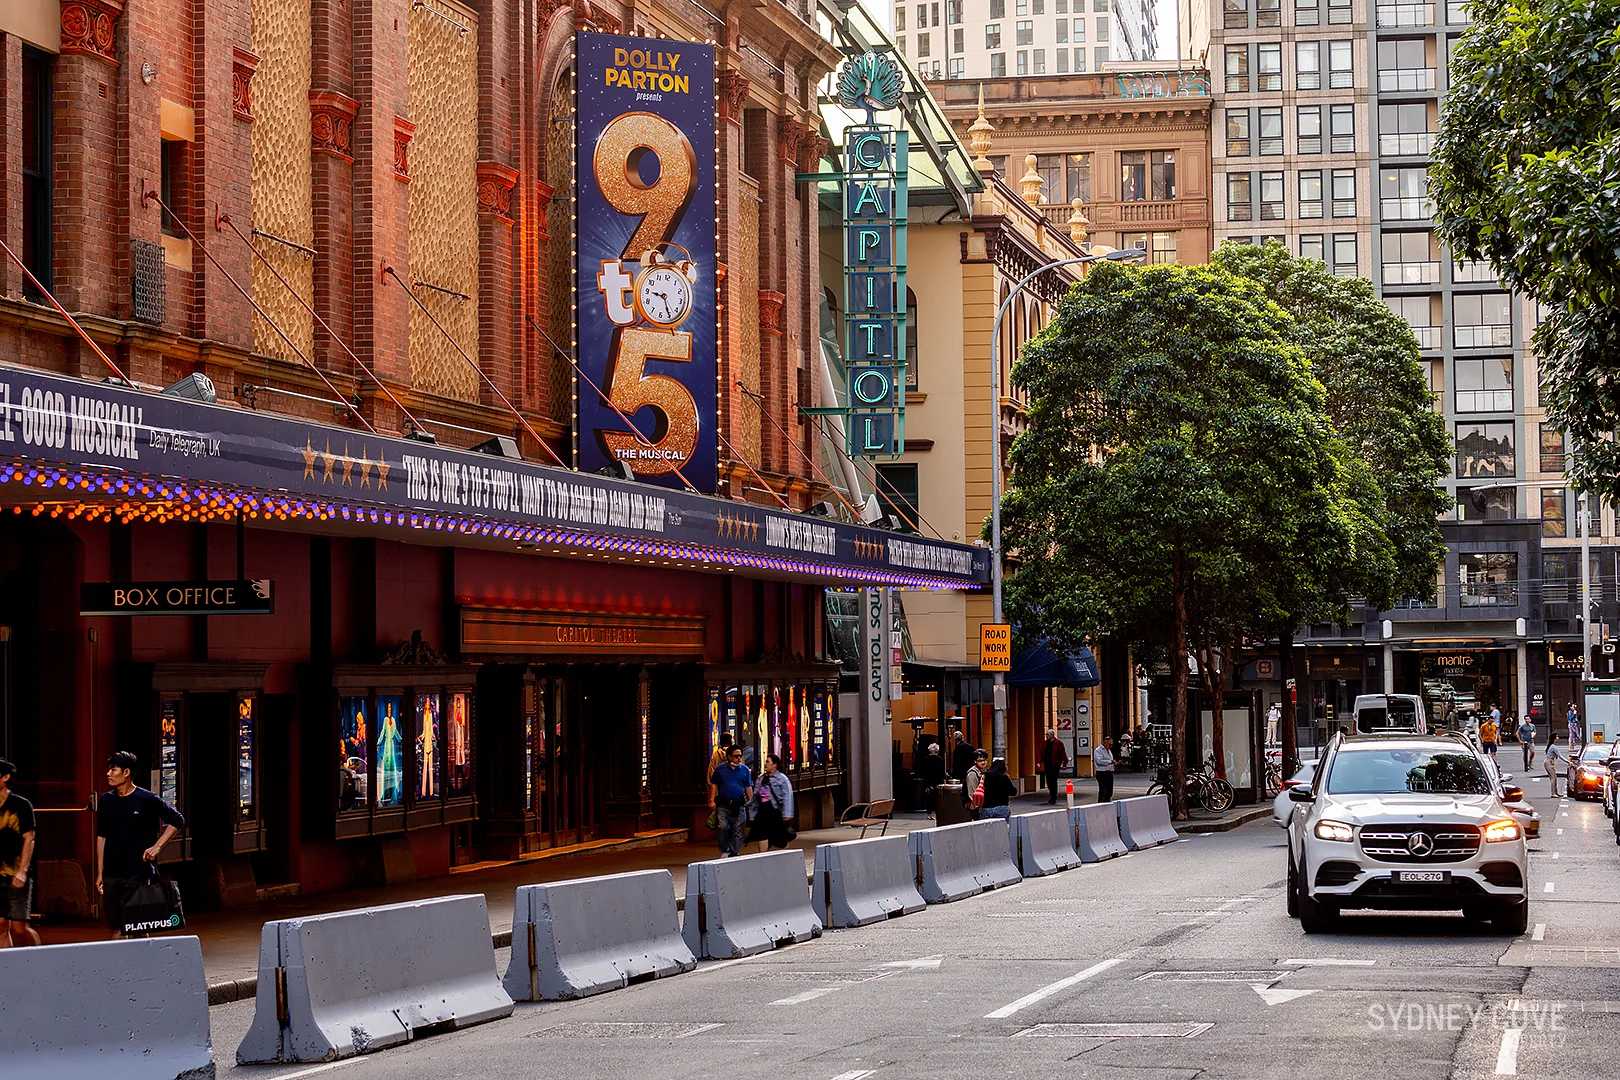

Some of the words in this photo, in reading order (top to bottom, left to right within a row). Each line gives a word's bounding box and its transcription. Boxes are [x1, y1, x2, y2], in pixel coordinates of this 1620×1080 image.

[614, 48, 680, 71] DOLLY
[606, 67, 689, 93] PARTON
[636, 92, 663, 102] presents
[593, 111, 699, 261] 9
[854, 134, 888, 450] CAPITOL
[593, 328, 700, 477] 5
[150, 429, 168, 453] Daily
[169, 432, 207, 458] Telegraph,
[208, 438, 221, 456] UK
[615, 449, 636, 459] THE
[638, 450, 686, 460] MUSICAL
[430, 459, 440, 502] IS
[441, 461, 460, 505] ONE
[461, 465, 469, 506] 9
[470, 466, 482, 508] TO
[482, 468, 490, 509] 5
[520, 475, 544, 516] WANT
[114, 588, 159, 606] BOX
[167, 588, 236, 605] OFFICE
[556, 626, 595, 642] CAPITOL
[600, 628, 637, 643] THEATRE
[985, 630, 1006, 639] ROAD
[985, 644, 1007, 652] WORK
[871, 634, 882, 702] CAPITOL
[982, 657, 1009, 666] AHEAD
[1438, 655, 1474, 665] mantra
[125, 920, 172, 932] PLATYPUS
